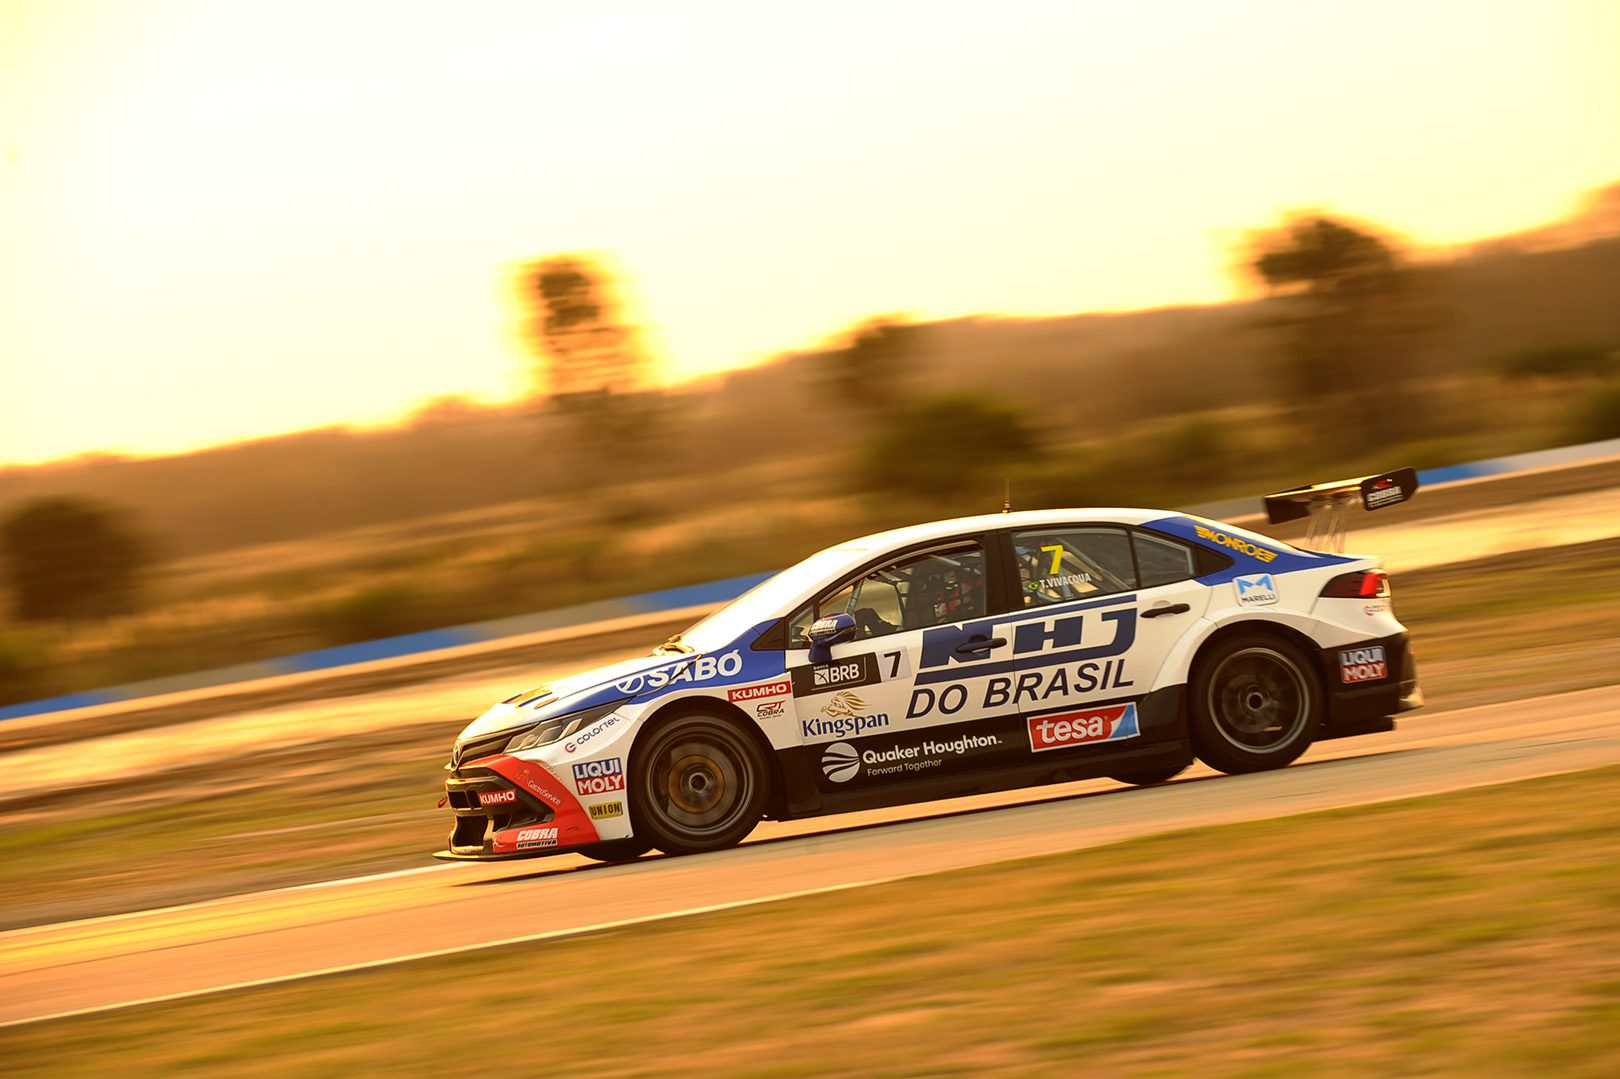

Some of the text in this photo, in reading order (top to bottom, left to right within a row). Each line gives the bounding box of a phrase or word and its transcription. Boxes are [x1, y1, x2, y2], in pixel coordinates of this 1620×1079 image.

[1193, 524, 1278, 563] MONROE
[1040, 544, 1064, 575] 7
[915, 606, 1137, 684] NHJ
[883, 651, 901, 678] 7
[1341, 648, 1384, 666] LIQUI
[831, 663, 859, 683] BRB
[1343, 663, 1385, 683] MOLY
[732, 684, 787, 700] KUMHO
[906, 659, 1134, 719] DO BRASIL
[802, 712, 889, 738] Kingspan
[1036, 715, 1103, 744] tesa
[863, 734, 997, 764] Quaker Houghton
[573, 759, 620, 779] LIQUI
[867, 759, 942, 777] Forward Together
[577, 775, 622, 794] MOLY
[480, 790, 515, 804] KUMHO
[590, 803, 620, 817] UNION
[517, 828, 558, 841] COBRA
[517, 839, 557, 848] AUTOMOTIVA
